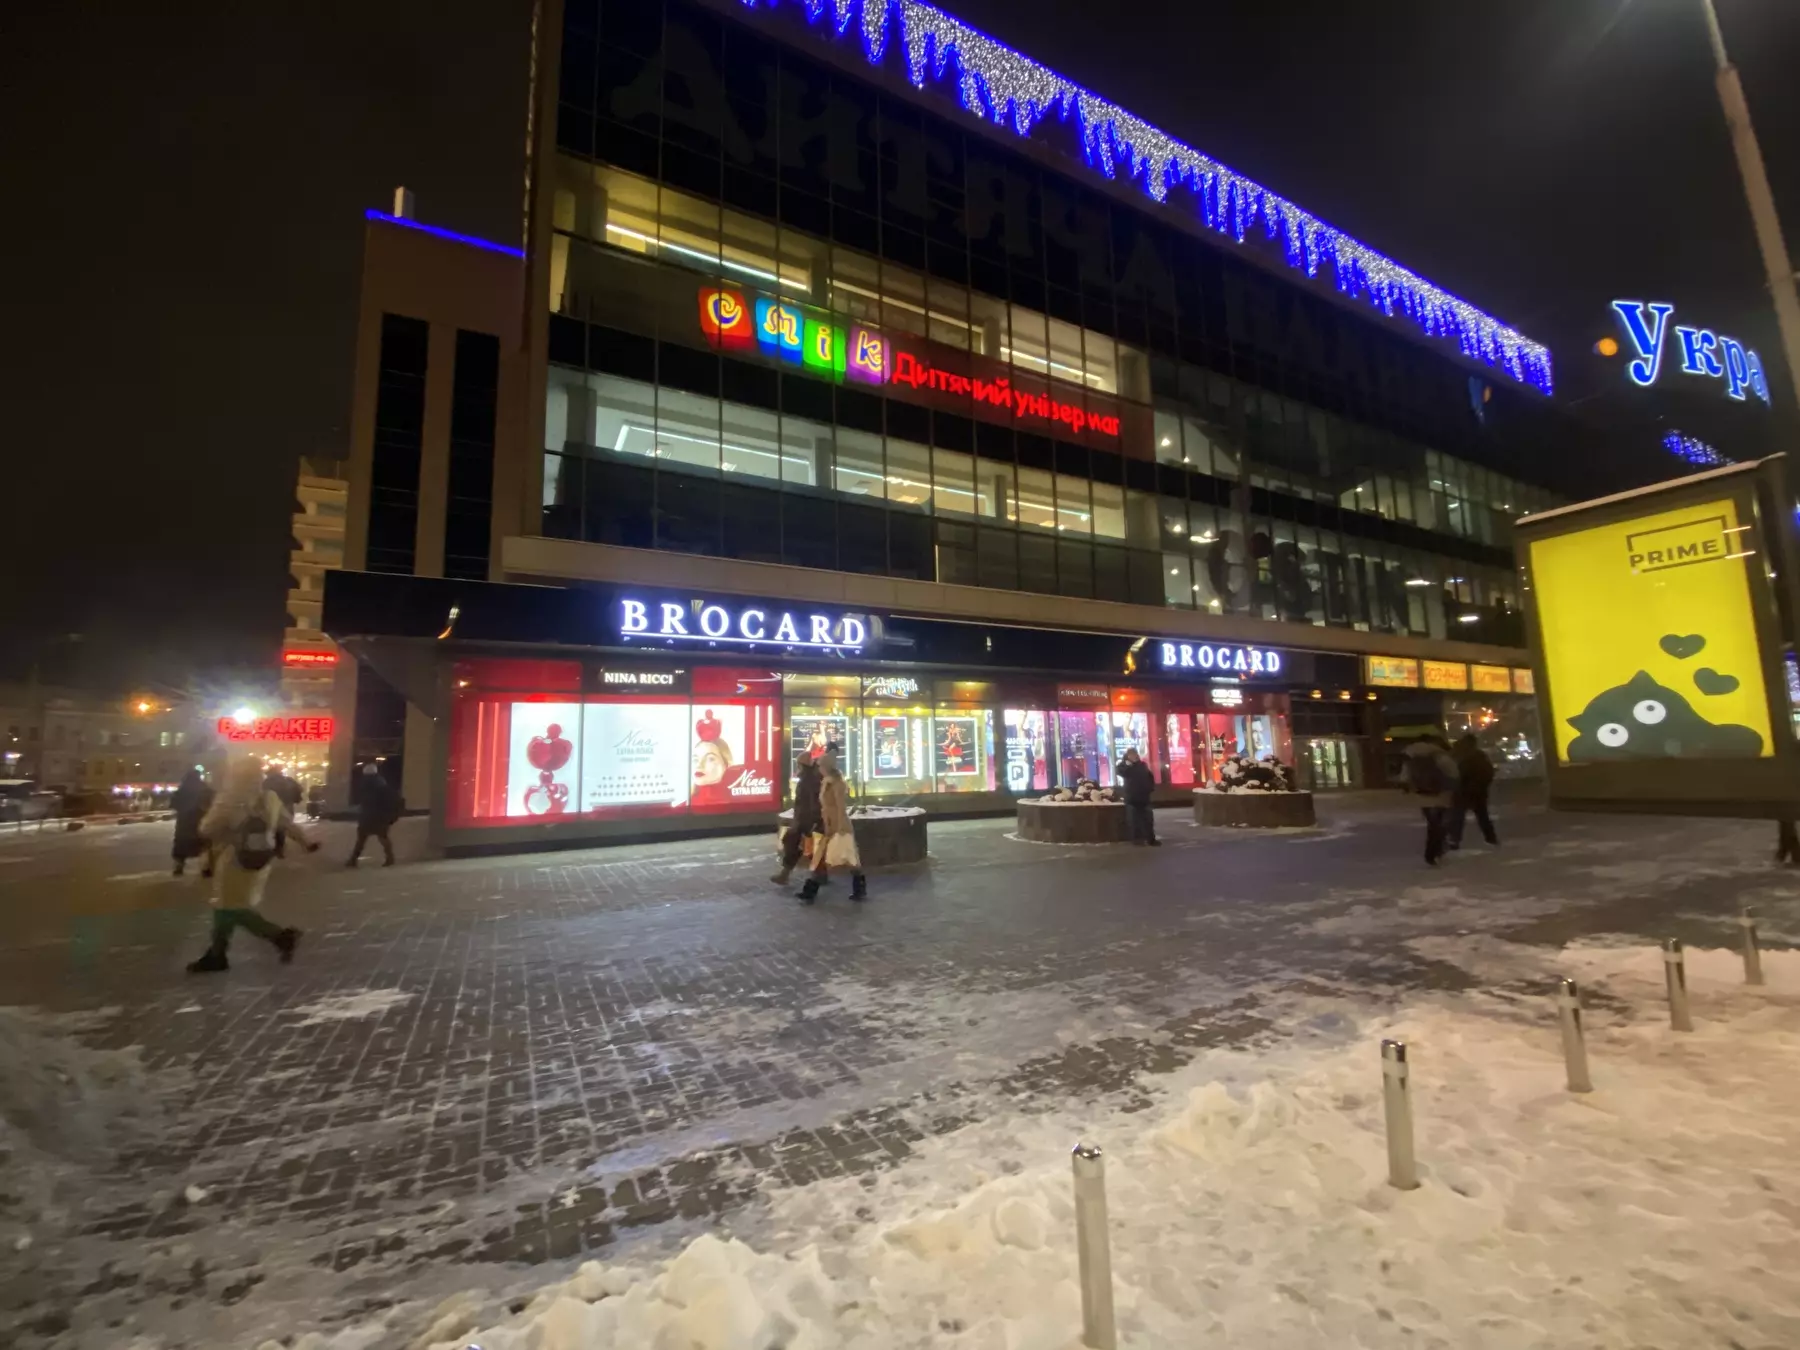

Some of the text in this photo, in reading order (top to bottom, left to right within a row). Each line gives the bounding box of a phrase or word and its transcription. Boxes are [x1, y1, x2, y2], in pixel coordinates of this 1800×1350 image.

[891, 351, 1012, 409] Дитячий
[1629, 539, 1720, 568] PRIME
[621, 599, 865, 645] BROCARD
[1162, 643, 1280, 672] BROCARD
[604, 672, 673, 685] NINA RICCI
[612, 730, 659, 748] Nina
[727, 769, 773, 789] Nina
